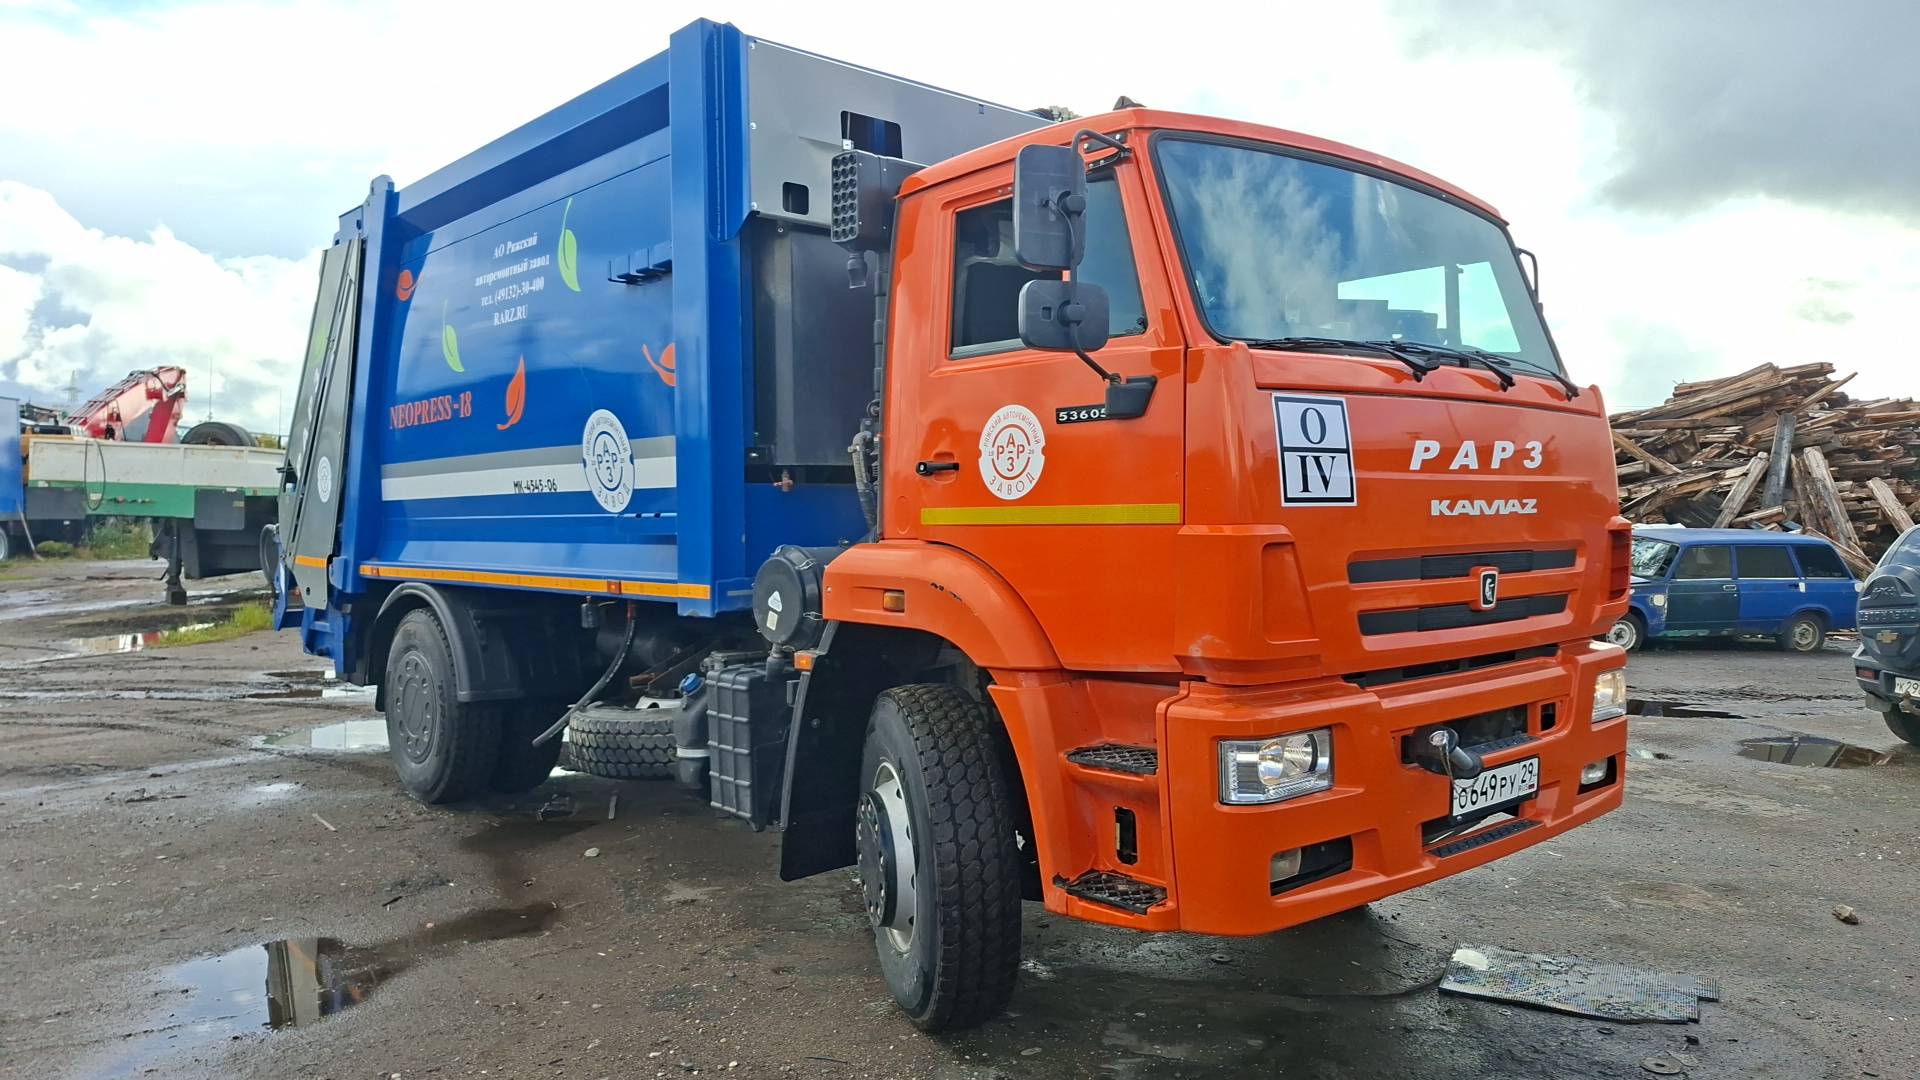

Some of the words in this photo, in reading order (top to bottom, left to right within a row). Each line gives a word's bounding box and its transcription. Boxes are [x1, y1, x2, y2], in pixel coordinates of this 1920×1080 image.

[493, 303, 528, 326] RARZ.RU
[1297, 455, 1336, 494] IV
[1431, 498, 1537, 516] KAMAZ
[1521, 762, 1534, 784] 29
